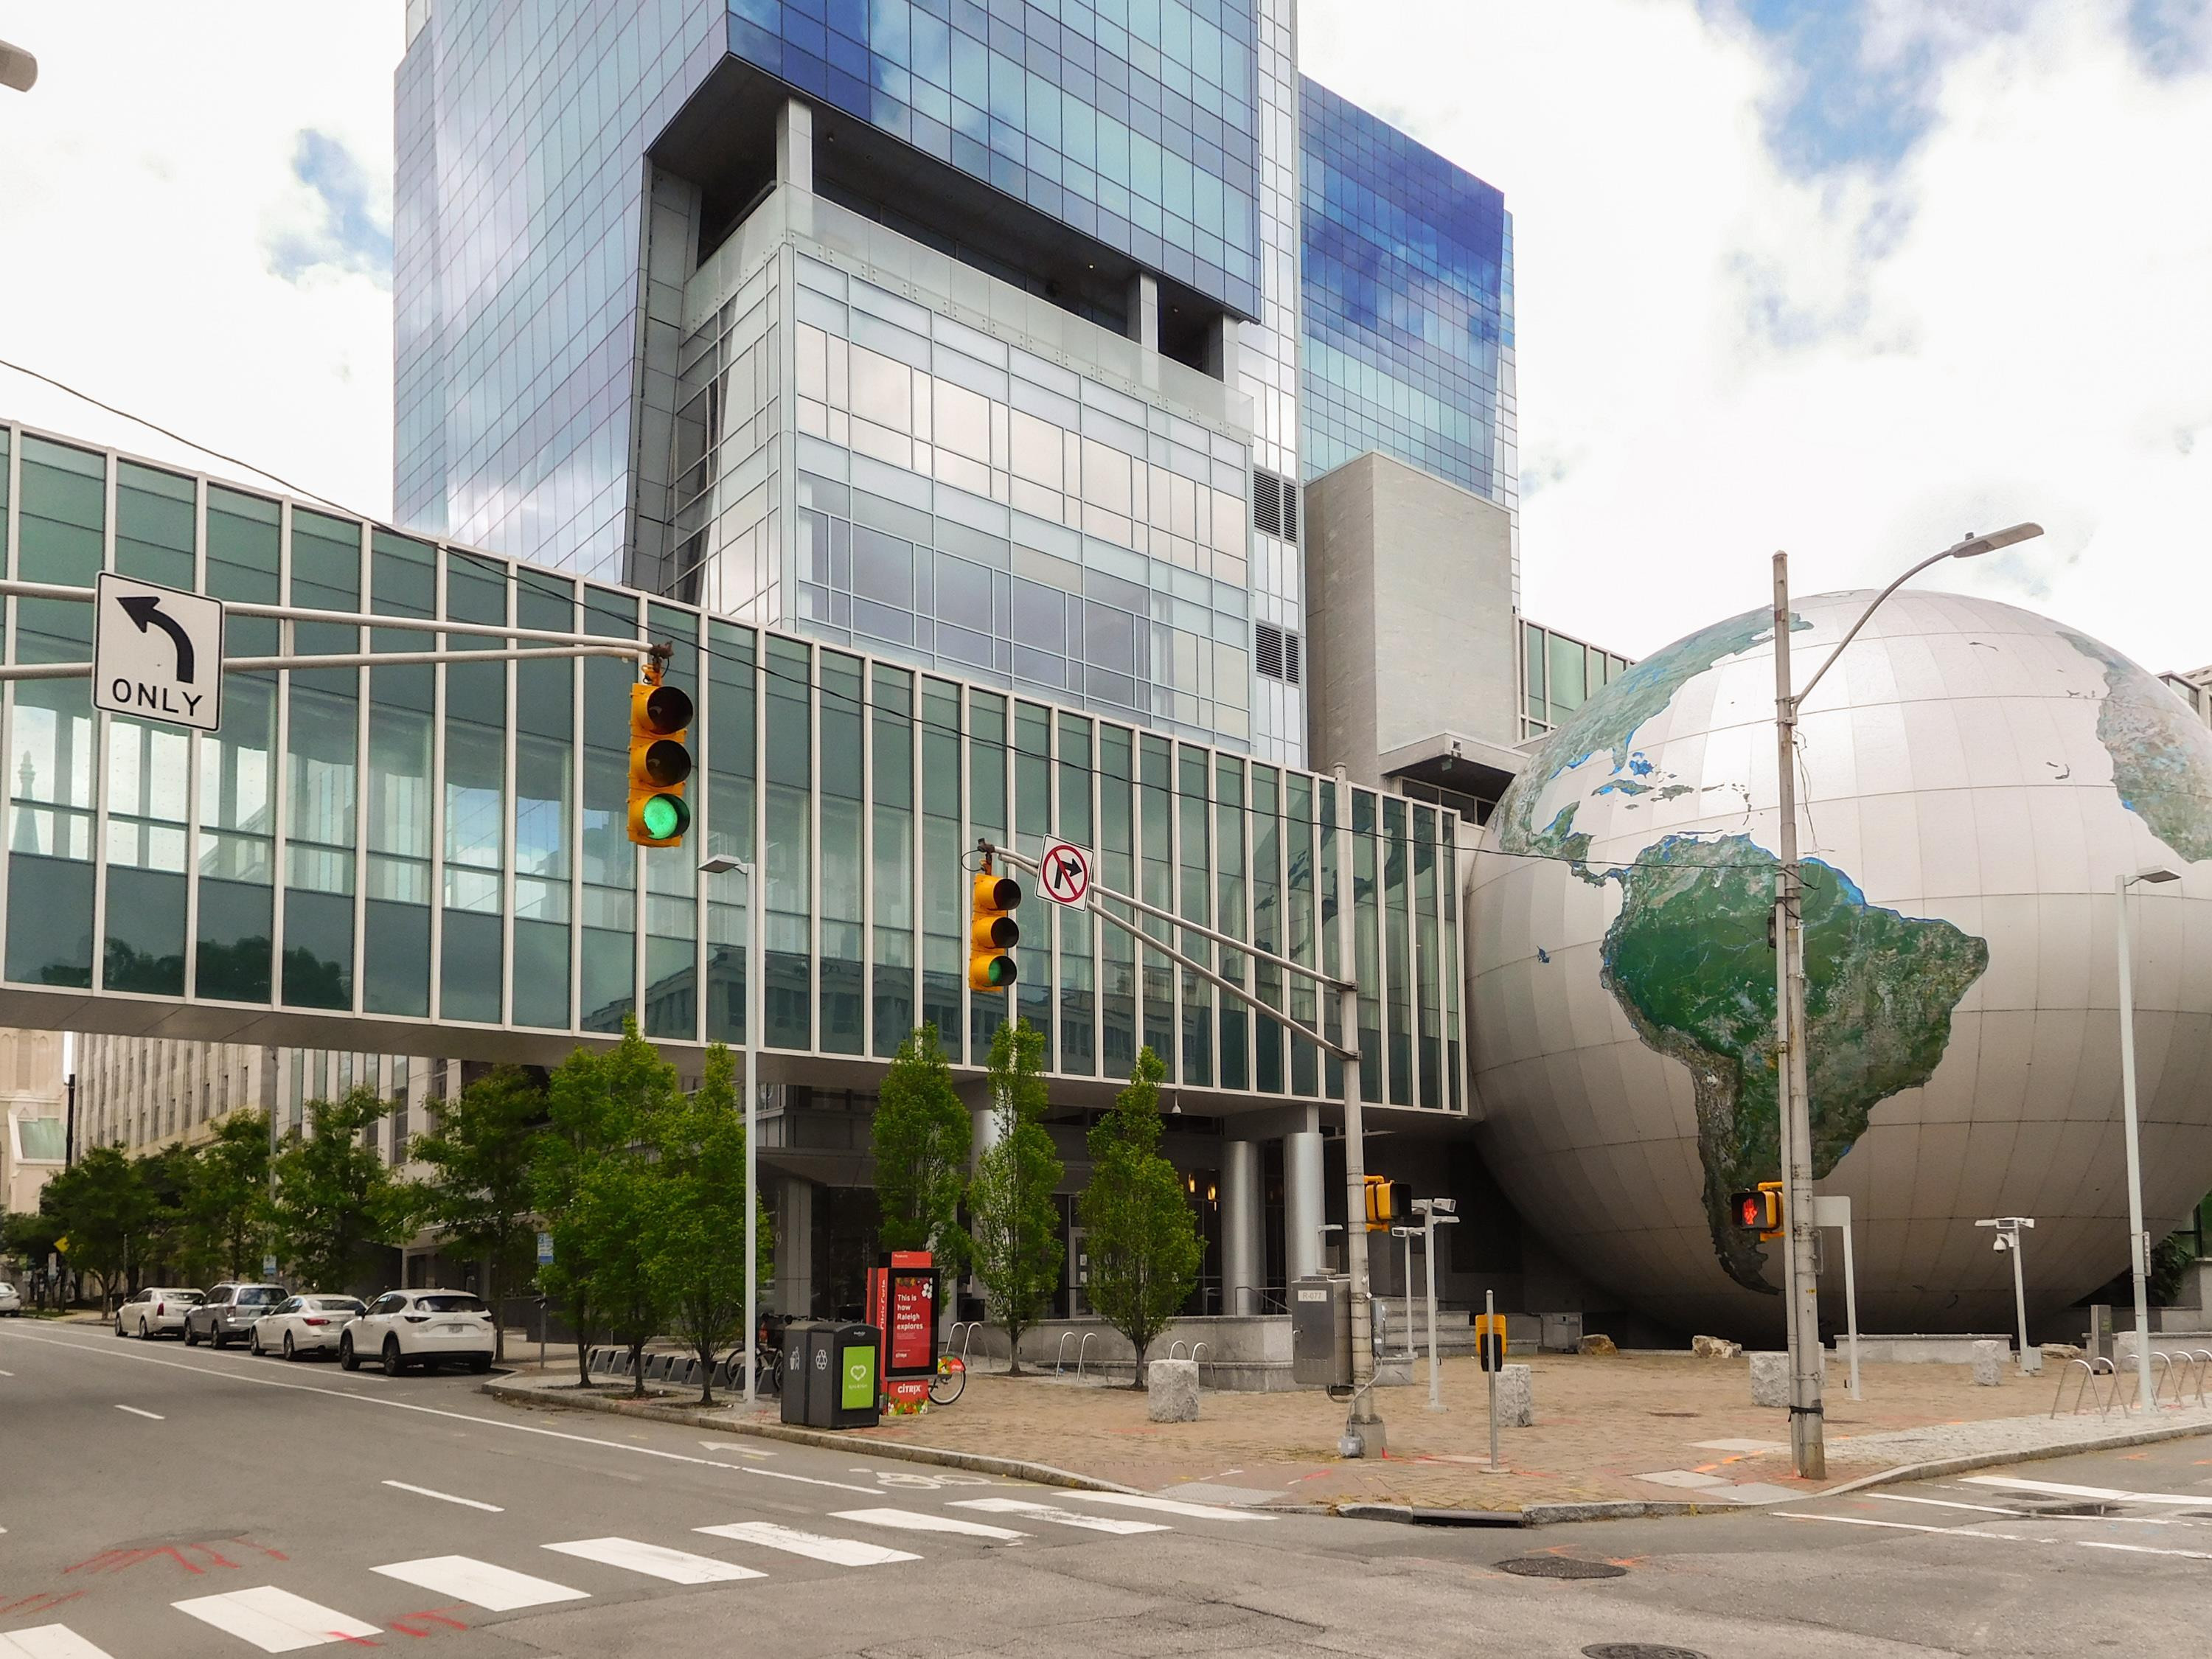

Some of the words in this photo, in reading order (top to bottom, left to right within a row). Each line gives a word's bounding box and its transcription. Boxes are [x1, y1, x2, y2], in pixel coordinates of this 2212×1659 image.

[112, 678, 203, 716] ONLY
[897, 1313, 920, 1321] Raleigh
[897, 1323, 923, 1331] explores
